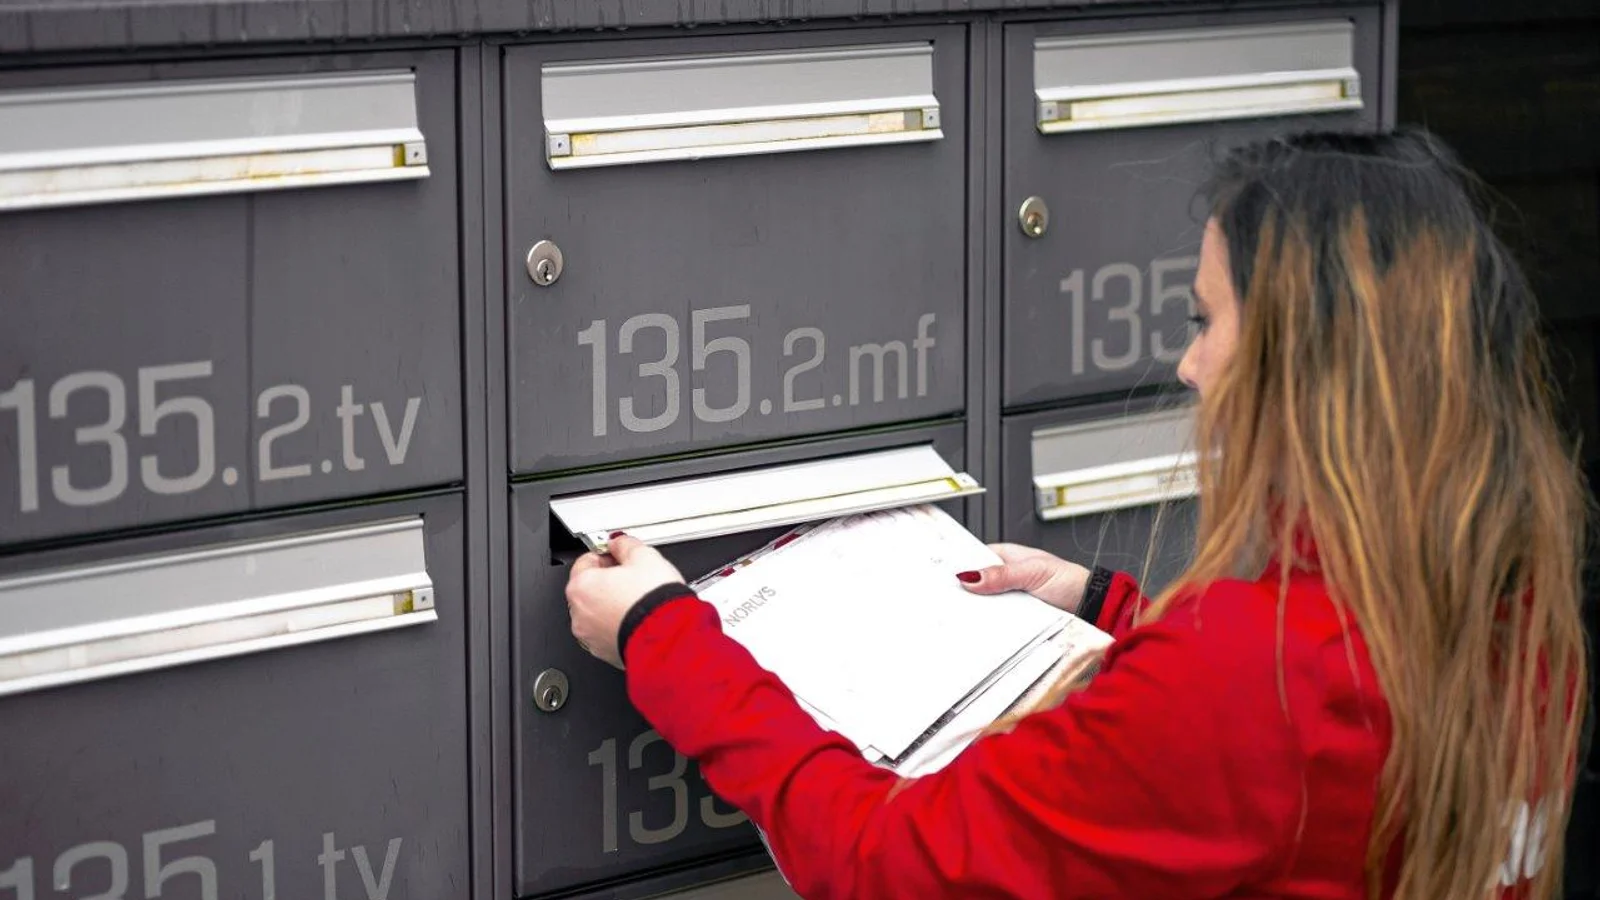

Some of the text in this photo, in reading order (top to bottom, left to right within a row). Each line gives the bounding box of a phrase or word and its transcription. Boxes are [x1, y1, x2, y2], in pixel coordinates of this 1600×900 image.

[0, 360, 422, 513] 135.2.tv
[577, 304, 936, 437] 135.2.mf
[723, 586, 776, 627] NORLYS
